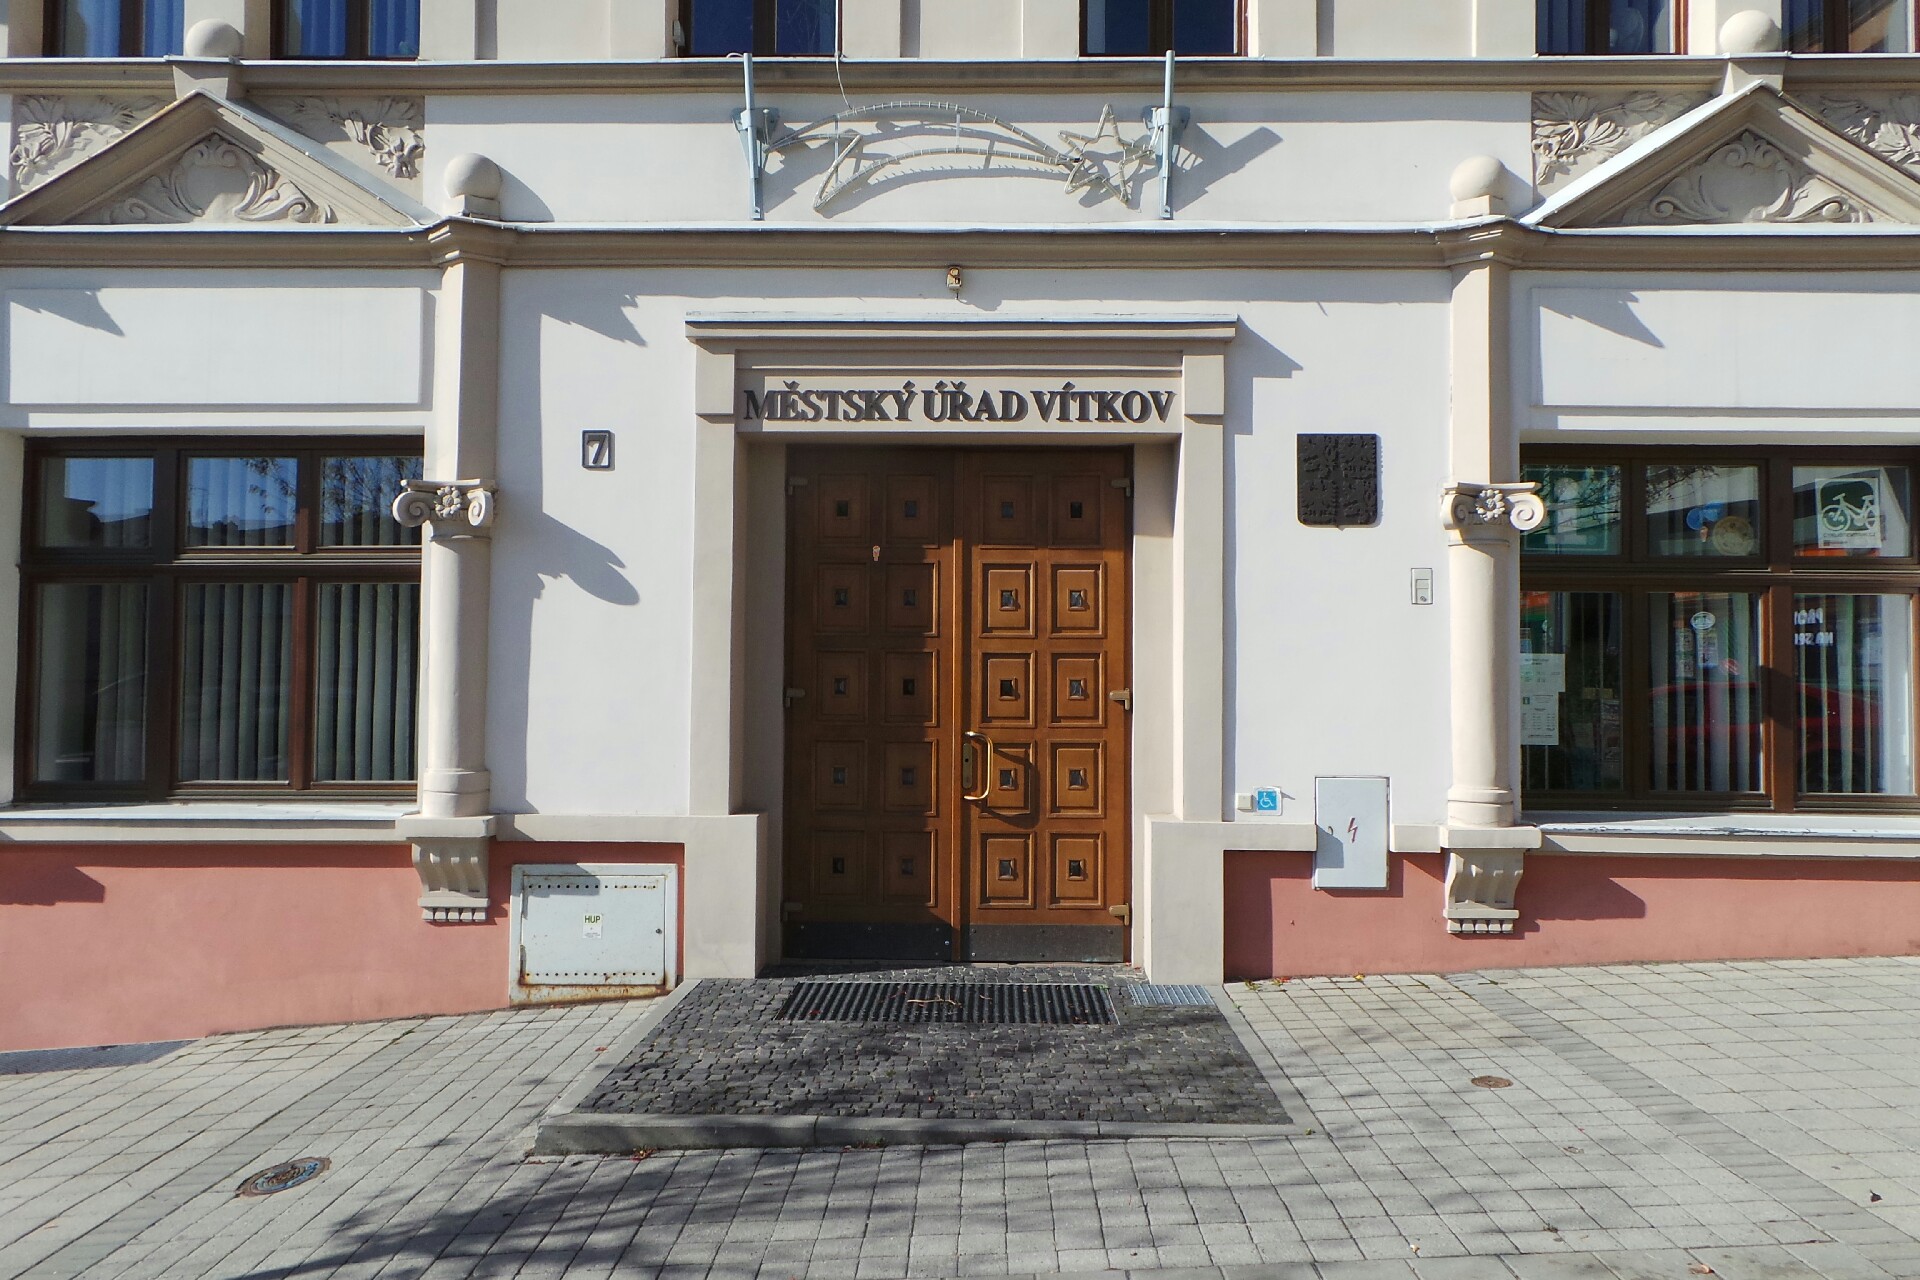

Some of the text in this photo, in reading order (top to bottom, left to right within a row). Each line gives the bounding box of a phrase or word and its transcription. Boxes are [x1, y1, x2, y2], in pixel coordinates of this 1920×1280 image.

[743, 380, 1177, 423] MĚSTSKÝ ÚŘAD VÍTKOV
[586, 434, 608, 465] 7
[584, 915, 601, 924] HUP
